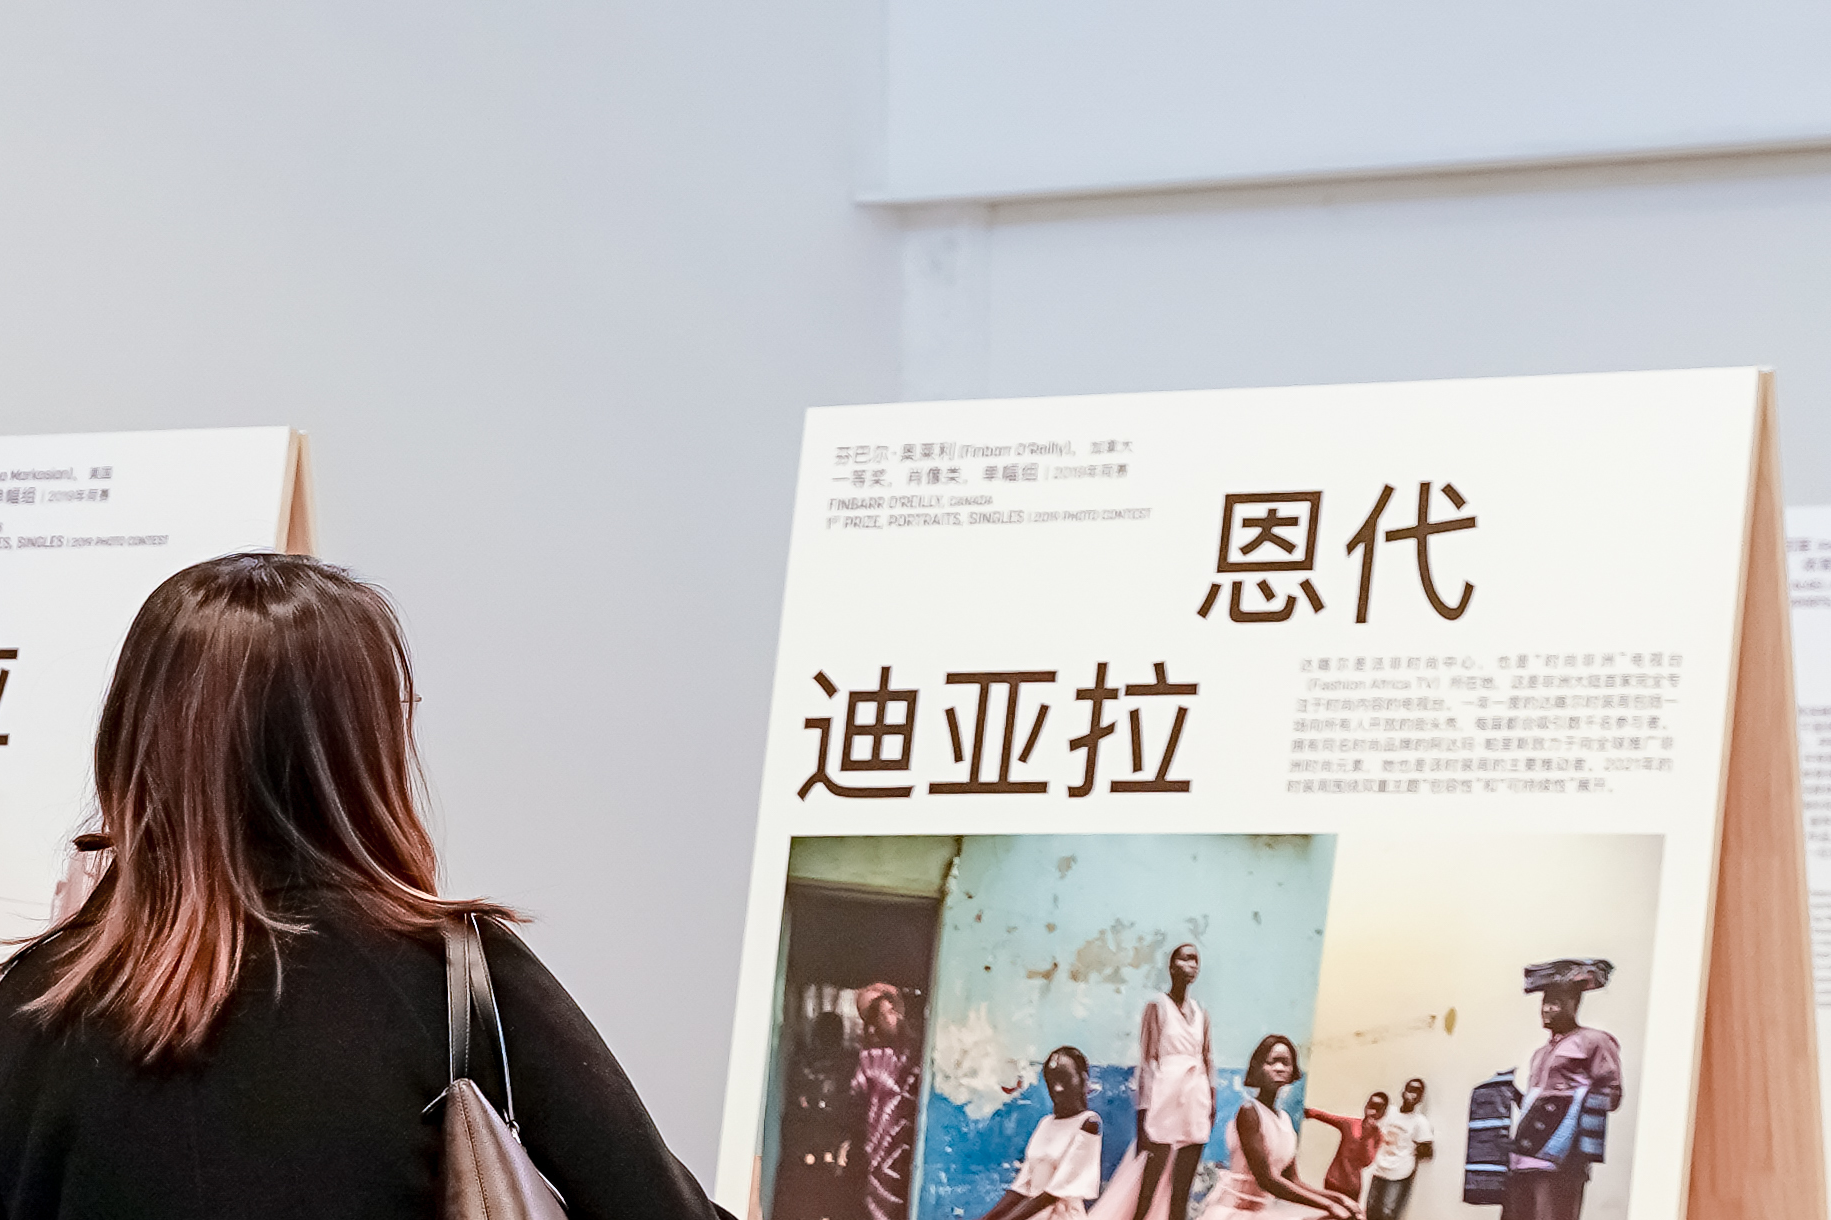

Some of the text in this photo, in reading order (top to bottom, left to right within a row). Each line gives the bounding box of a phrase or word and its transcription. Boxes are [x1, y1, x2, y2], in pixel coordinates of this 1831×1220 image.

[1197, 480, 1477, 623] 恩代
[797, 661, 1200, 800] 迪亚拉
